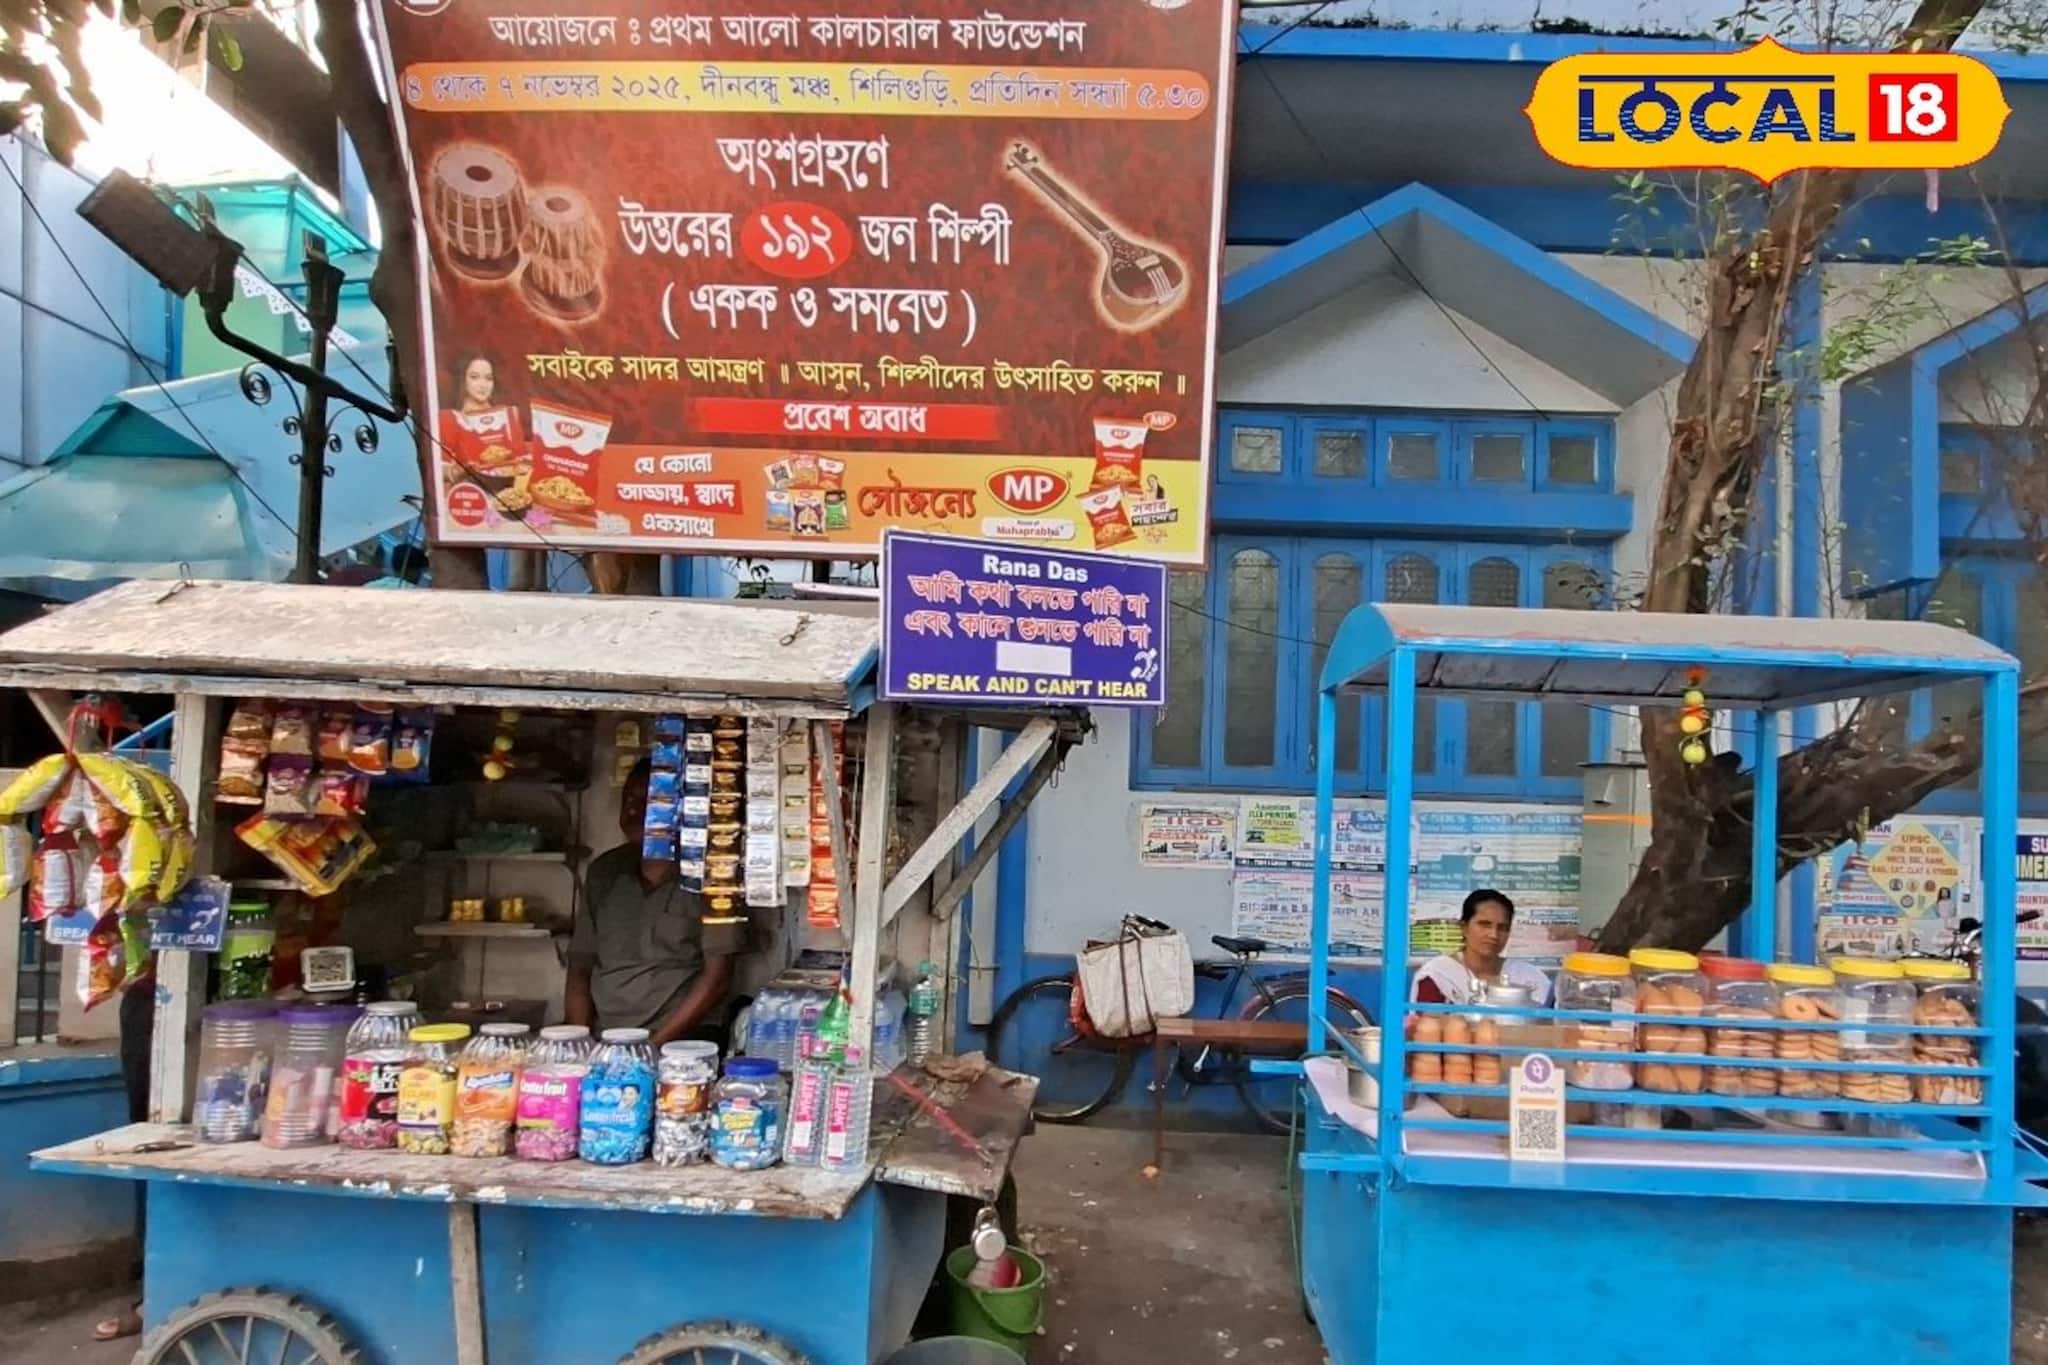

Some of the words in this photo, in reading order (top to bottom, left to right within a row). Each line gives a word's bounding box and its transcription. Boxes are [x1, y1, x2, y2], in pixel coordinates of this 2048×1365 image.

[489, 15, 616, 48] আয়োজনে
[650, 15, 712, 48] প্রথম
[722, 16, 800, 50] আলো
[810, 14, 940, 50] কালচারাল
[951, 11, 1087, 52] ফাউন্ডেশন
[432, 75, 488, 100] থেকে
[499, 77, 514, 99] ৭
[523, 74, 600, 101] নভেম্বর
[700, 65, 782, 106] দীনবন্ধু
[969, 72, 1061, 106] প্রতিদিন
[1070, 78, 1128, 108] সন্ধ্যা
[716, 131, 890, 193] অংশগ্রহণে
[618, 195, 733, 260] উত্তরের
[759, 213, 835, 267] ১৯২
[859, 213, 917, 265] জন
[928, 201, 1013, 266] শিল্পী
[689, 283, 778, 330] একক
[790, 286, 818, 329] ও
[828, 287, 949, 336] সমবেত
[527, 347, 613, 383] সবাইকে
[620, 354, 679, 383] সাদর
[686, 356, 765, 386] আমন্ত্রণ
[877, 356, 985, 392] শিল্পীদের
[993, 358, 1095, 396] উৎসাহিত
[1102, 368, 1163, 396] করুন
[783, 402, 852, 432] প্রবেশ
[859, 405, 928, 434] অবাধ
[660, 452, 712, 474] কোনো
[857, 467, 977, 520] সৌজন্যে
[1003, 474, 1054, 502] MP
[641, 513, 715, 538] একসাথে
[982, 554, 1041, 578] Rana
[1047, 560, 1088, 583] Das
[907, 569, 965, 604] আমি
[966, 579, 1014, 609] কথা
[1015, 583, 1078, 611] বলতে
[1081, 585, 1124, 617] পারি
[1127, 592, 1150, 620] না
[904, 608, 953, 638] এবং
[956, 610, 1014, 641] কানে
[1016, 616, 1080, 644] শুনতে
[1083, 617, 1127, 647] পারি
[1128, 623, 1152, 649] না
[907, 672, 980, 693] SPEAK
[987, 676, 1030, 694] AND
[1034, 679, 1093, 697] CAN'T
[1098, 682, 1148, 698] HEAR
